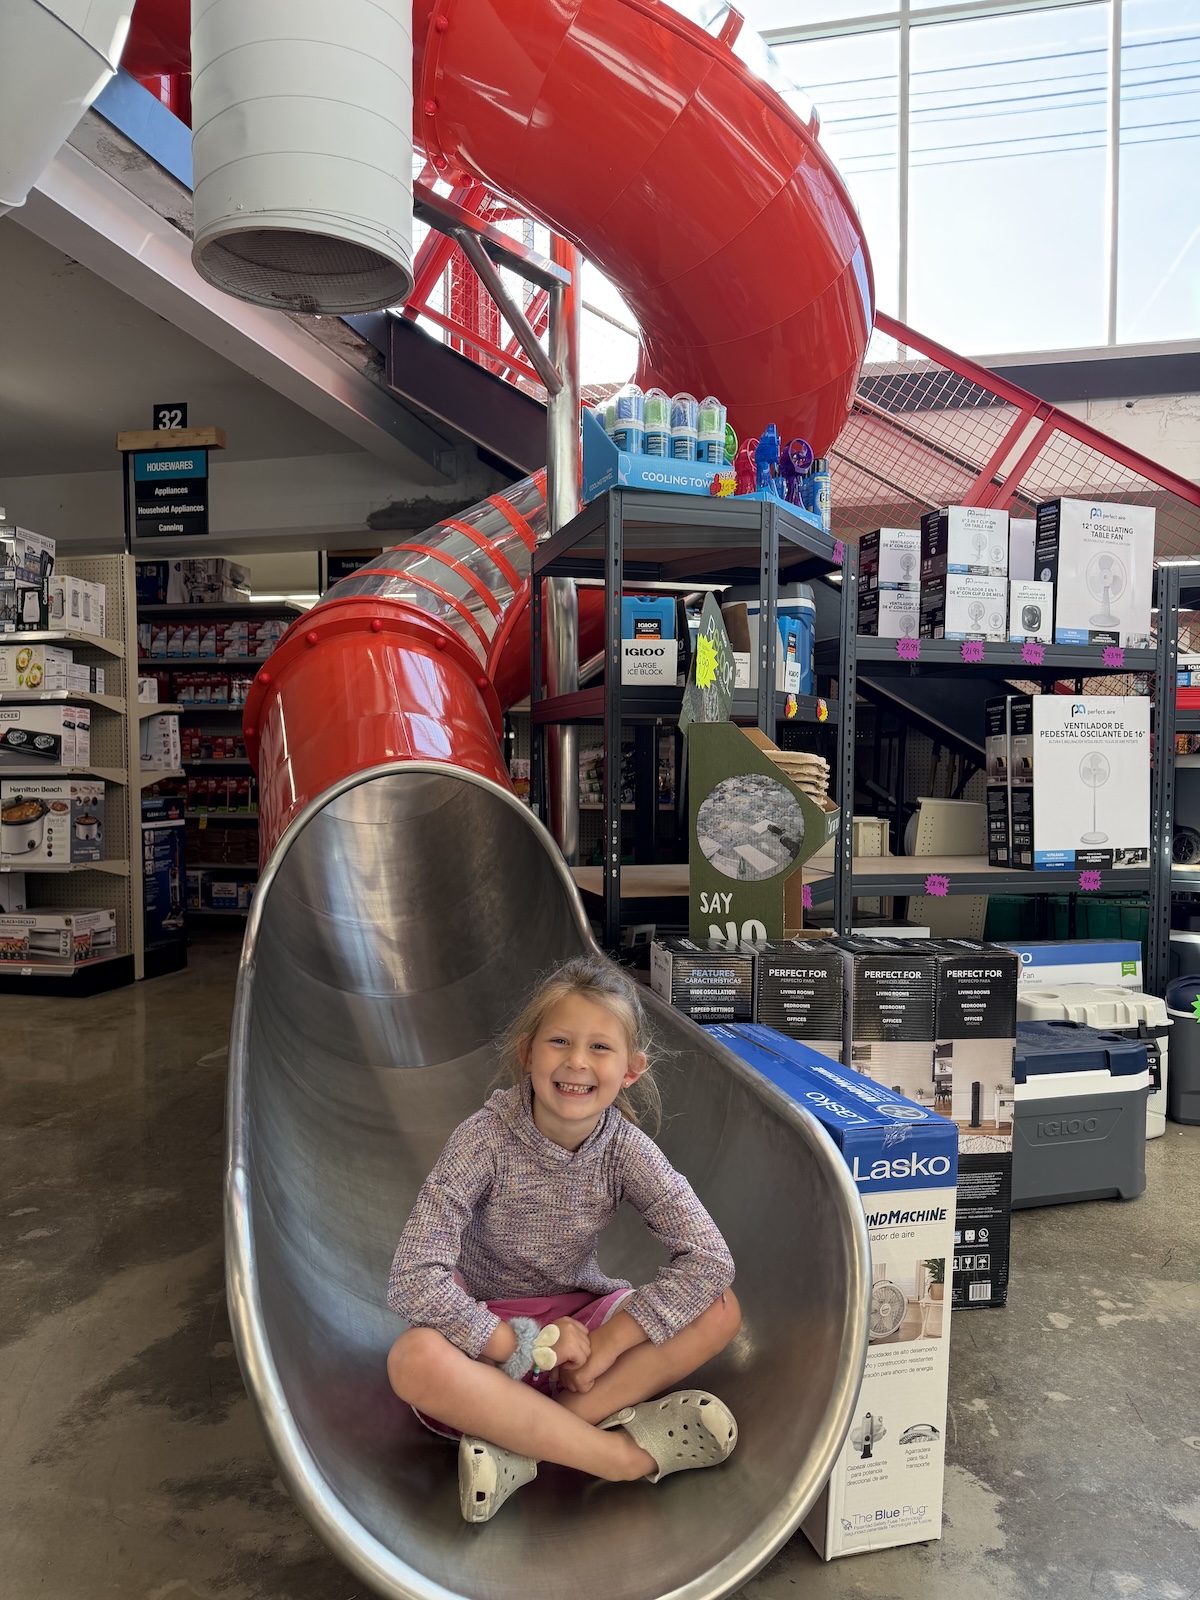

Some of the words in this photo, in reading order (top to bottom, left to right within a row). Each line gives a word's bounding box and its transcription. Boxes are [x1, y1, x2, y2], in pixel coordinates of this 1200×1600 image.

[158, 409, 182, 430] 32
[146, 460, 194, 472] HOUSEWARES
[641, 471, 688, 486] COOLING
[154, 486, 188, 496] Appliances
[138, 505, 170, 515] Household
[170, 504, 205, 514] Appliances
[1103, 513, 1118, 521] perfect
[158, 523, 184, 532] Canning
[1082, 522, 1093, 530] 12"
[1093, 524, 1134, 535] OSCILLATING
[1091, 531, 1110, 539] TABLE
[1110, 532, 1124, 541] FAN
[625, 647, 665, 656] IGLOO
[901, 643, 918, 651] 28.99
[965, 647, 980, 655] 21.99
[1087, 708, 1106, 716] perfect
[1063, 722, 1113, 730] VENTILADOR
[1114, 722, 1125, 730] DE
[1039, 730, 1079, 738] PEDESTAL
[1080, 730, 1122, 738] OSCILANTE
[1123, 730, 1133, 738] DE
[1134, 730, 1146, 738] 16"
[700, 891, 733, 914] SAY
[691, 969, 735, 977] FEATURES
[769, 969, 808, 978] PERFECT
[808, 970, 828, 978] FOR
[864, 971, 902, 979] PERFECT
[903, 971, 922, 979] FOR
[946, 970, 984, 978] PERFECT
[984, 970, 1003, 978] FOR
[684, 976, 742, 985] CARACTERÍSTICAS
[806, 1091, 869, 1125] Lasko
[1036, 1116, 1099, 1138] IGLOO
[853, 1152, 951, 1182] Lasko
[864, 1207, 947, 1227] INDMACHINE
[870, 1233, 888, 1242] lador
[890, 1231, 900, 1239] de
[901, 1230, 915, 1238] aire
[910, 1346, 938, 1354] desempeño
[877, 1359, 908, 1368] construcción
[904, 1447, 931, 1456] Agarradera
[846, 1464, 867, 1472] Cabezal
[867, 1460, 888, 1468] oscilante
[905, 1461, 931, 1469] transporte
[862, 1468, 883, 1477] potencia
[846, 1478, 871, 1487] direccional
[852, 1514, 873, 1525] The
[875, 1509, 901, 1520] Blue
[902, 1505, 926, 1518] Plug
